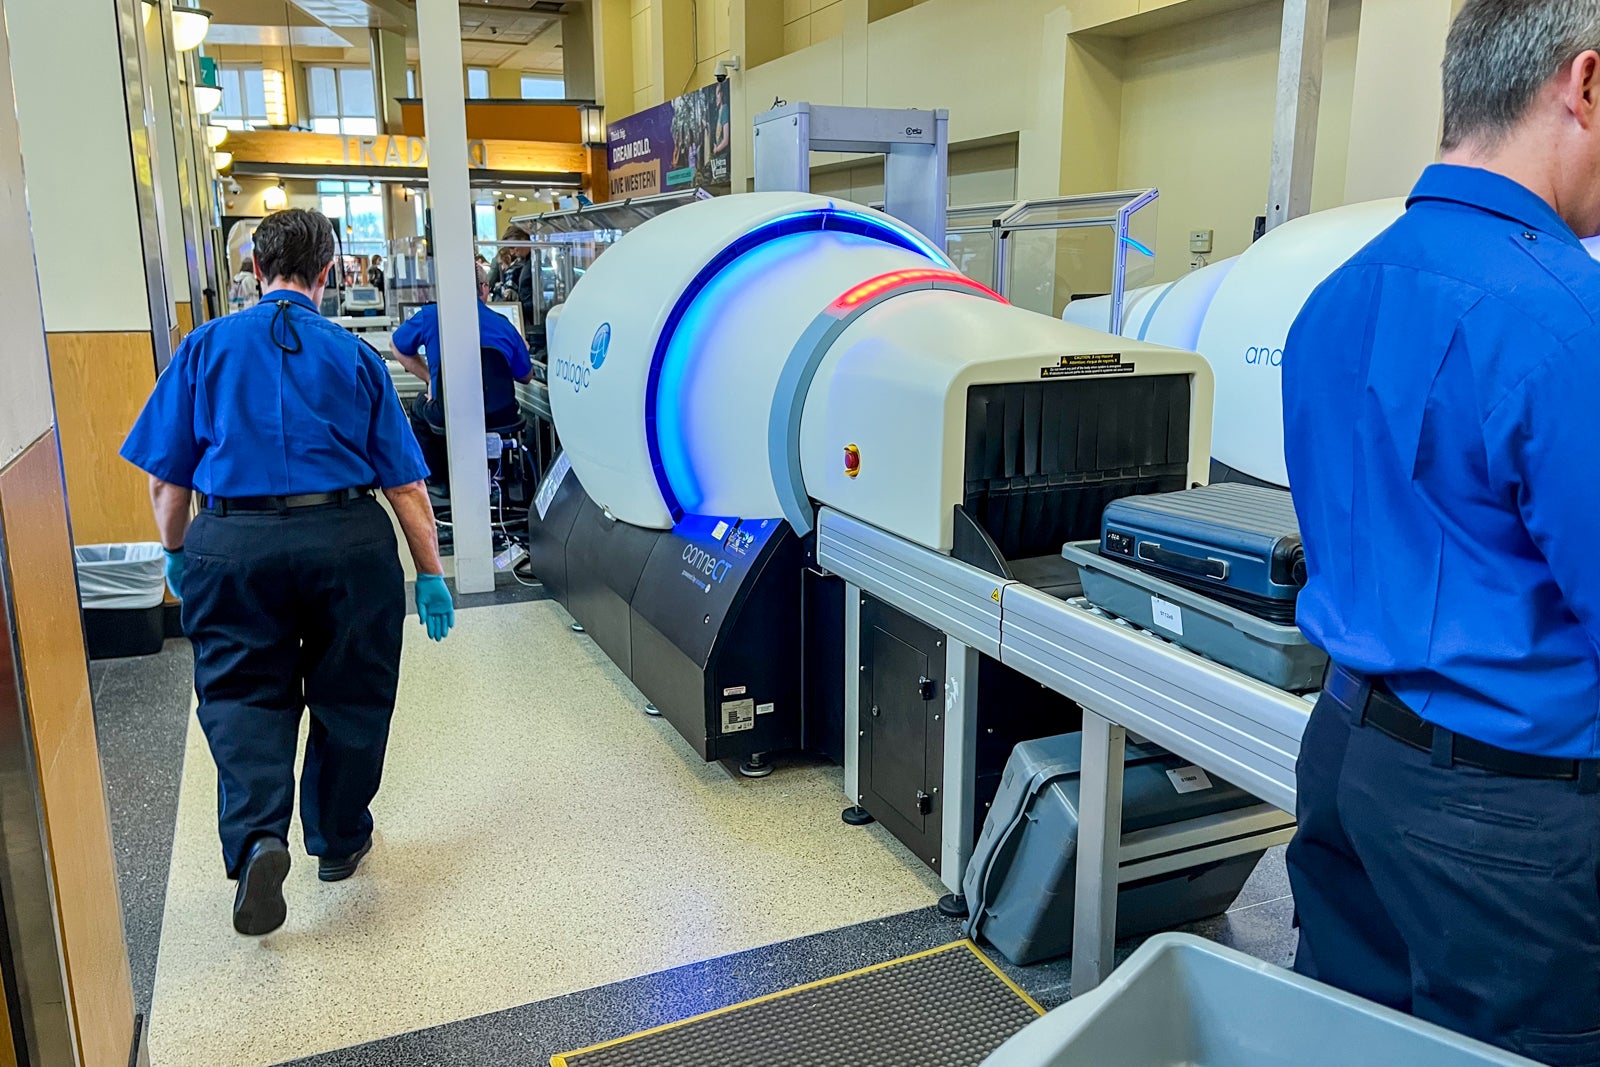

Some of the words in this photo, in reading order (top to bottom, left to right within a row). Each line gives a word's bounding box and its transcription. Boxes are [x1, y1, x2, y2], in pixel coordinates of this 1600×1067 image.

[613, 143, 632, 163] DREAM
[633, 138, 651, 158] BOLD.
[611, 177, 624, 195] LIVE
[625, 169, 656, 192] WESTERN
[1245, 346, 1283, 367] ana
[555, 354, 591, 393] analogic
[682, 543, 733, 584] conneCT
